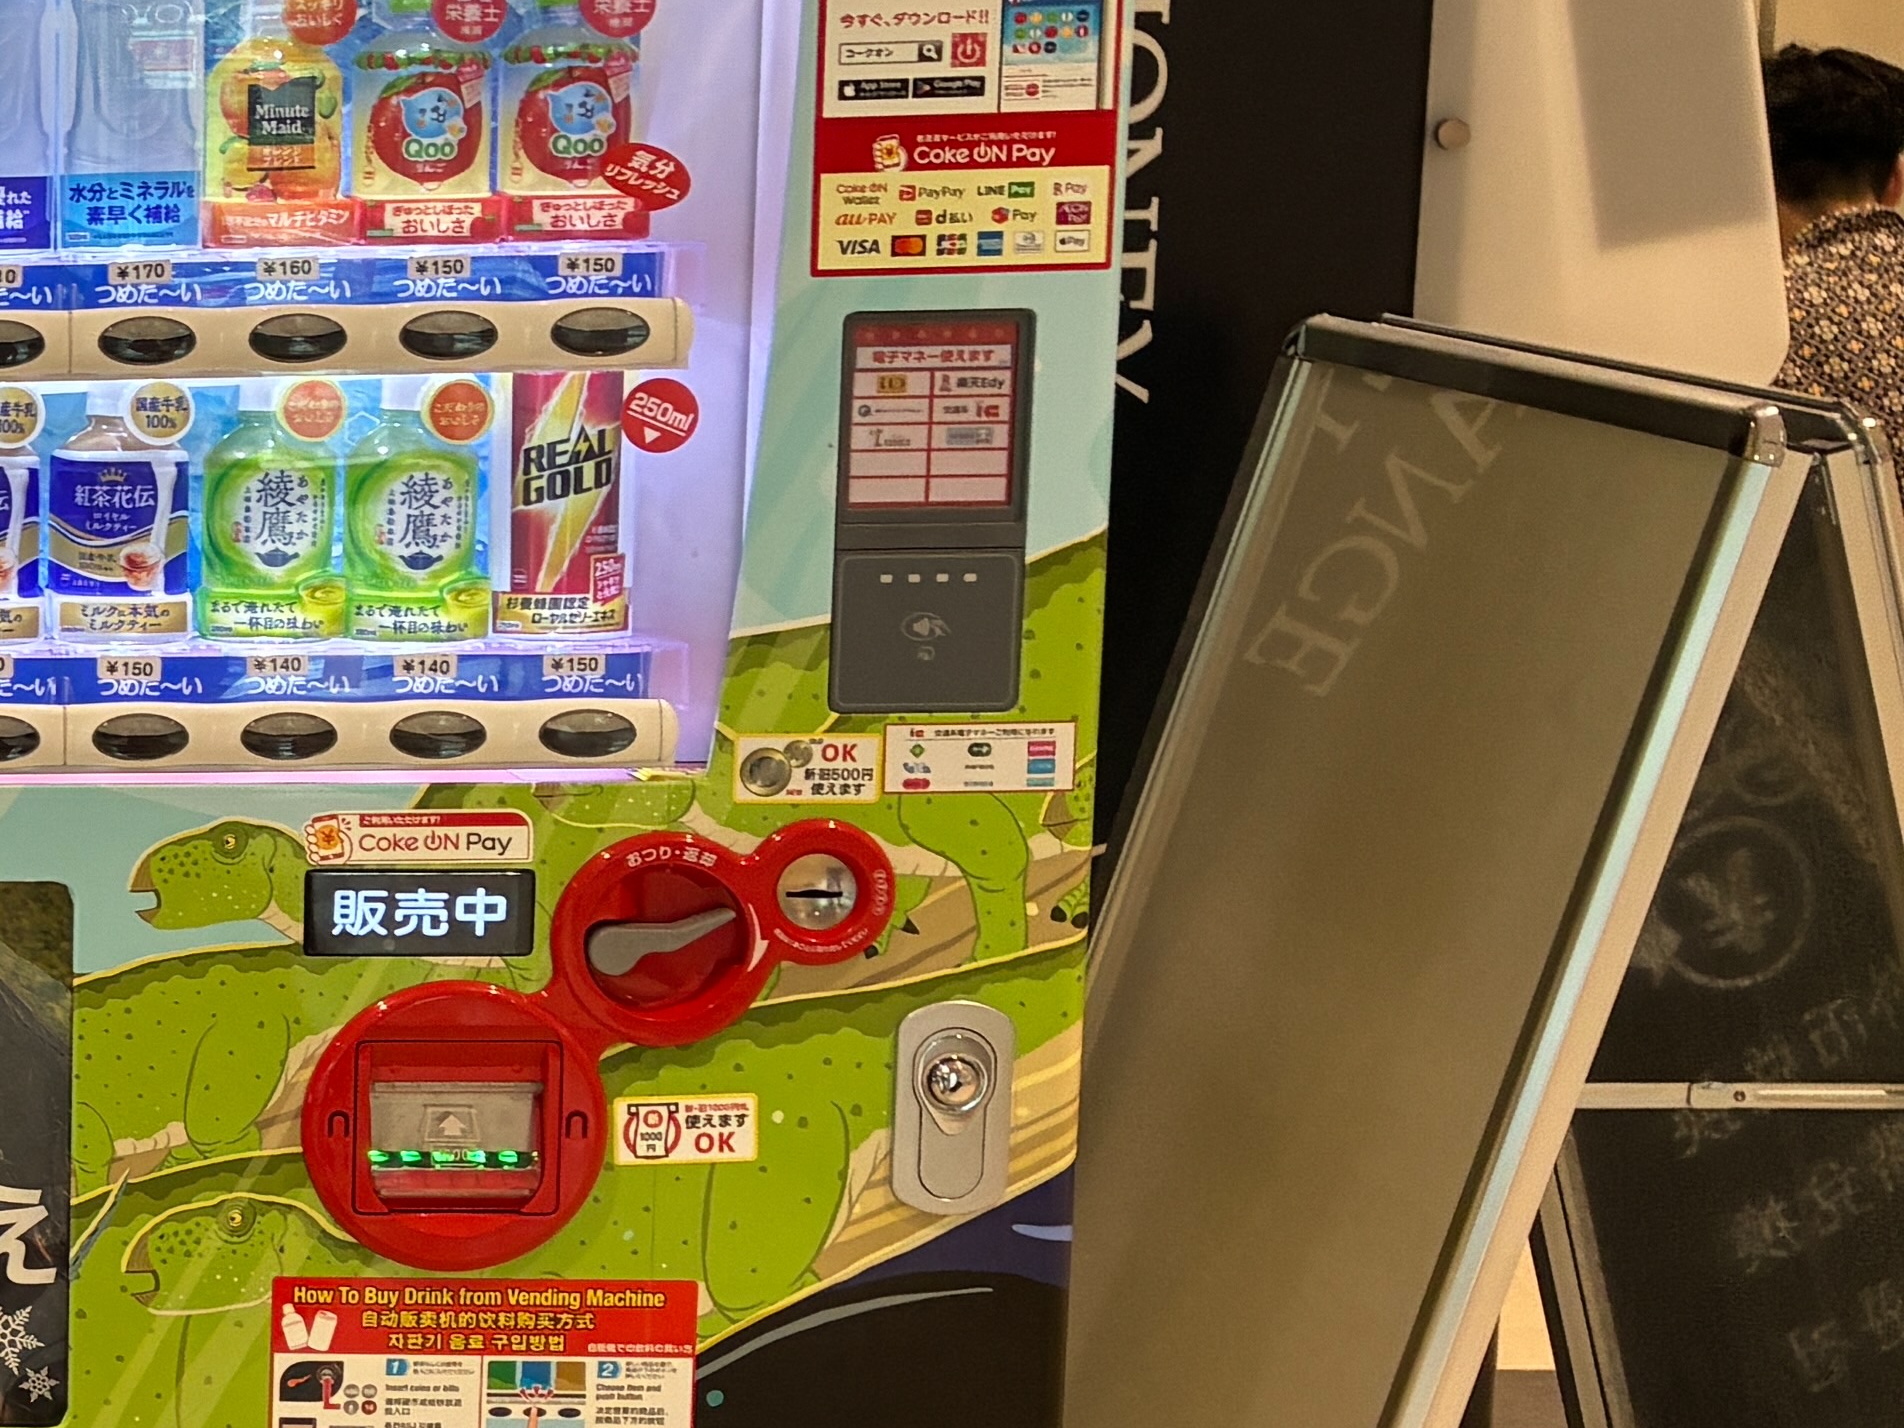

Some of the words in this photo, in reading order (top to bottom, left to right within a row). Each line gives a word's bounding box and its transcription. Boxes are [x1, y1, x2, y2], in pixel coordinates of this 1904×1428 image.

[404, 138, 454, 160] Qoo
[914, 145, 970, 165] Coke
[1013, 143, 1055, 166] Pay
[402, 217, 466, 234] おいしさ
[838, 240, 881, 255] VISA
[629, 393, 694, 431] 250ml
[521, 427, 613, 476] REAL
[522, 464, 613, 507] GOLD
[821, 743, 858, 762] OK
[358, 833, 419, 852] Coke
[466, 833, 512, 855] Pay
[332, 887, 508, 936] 販売中
[685, 1114, 747, 1129] 使えます
[693, 1132, 735, 1153] OK
[294, 1287, 336, 1304] How
[338, 1287, 360, 1304] To
[364, 1287, 399, 1307] Buy
[404, 1287, 453, 1305] Drink
[459, 1288, 502, 1306] from
[507, 1289, 581, 1309] Vending
[587, 1289, 665, 1308] Machine
[388, 1335, 441, 1351] 자판기
[491, 1335, 564, 1352] 구입방법
